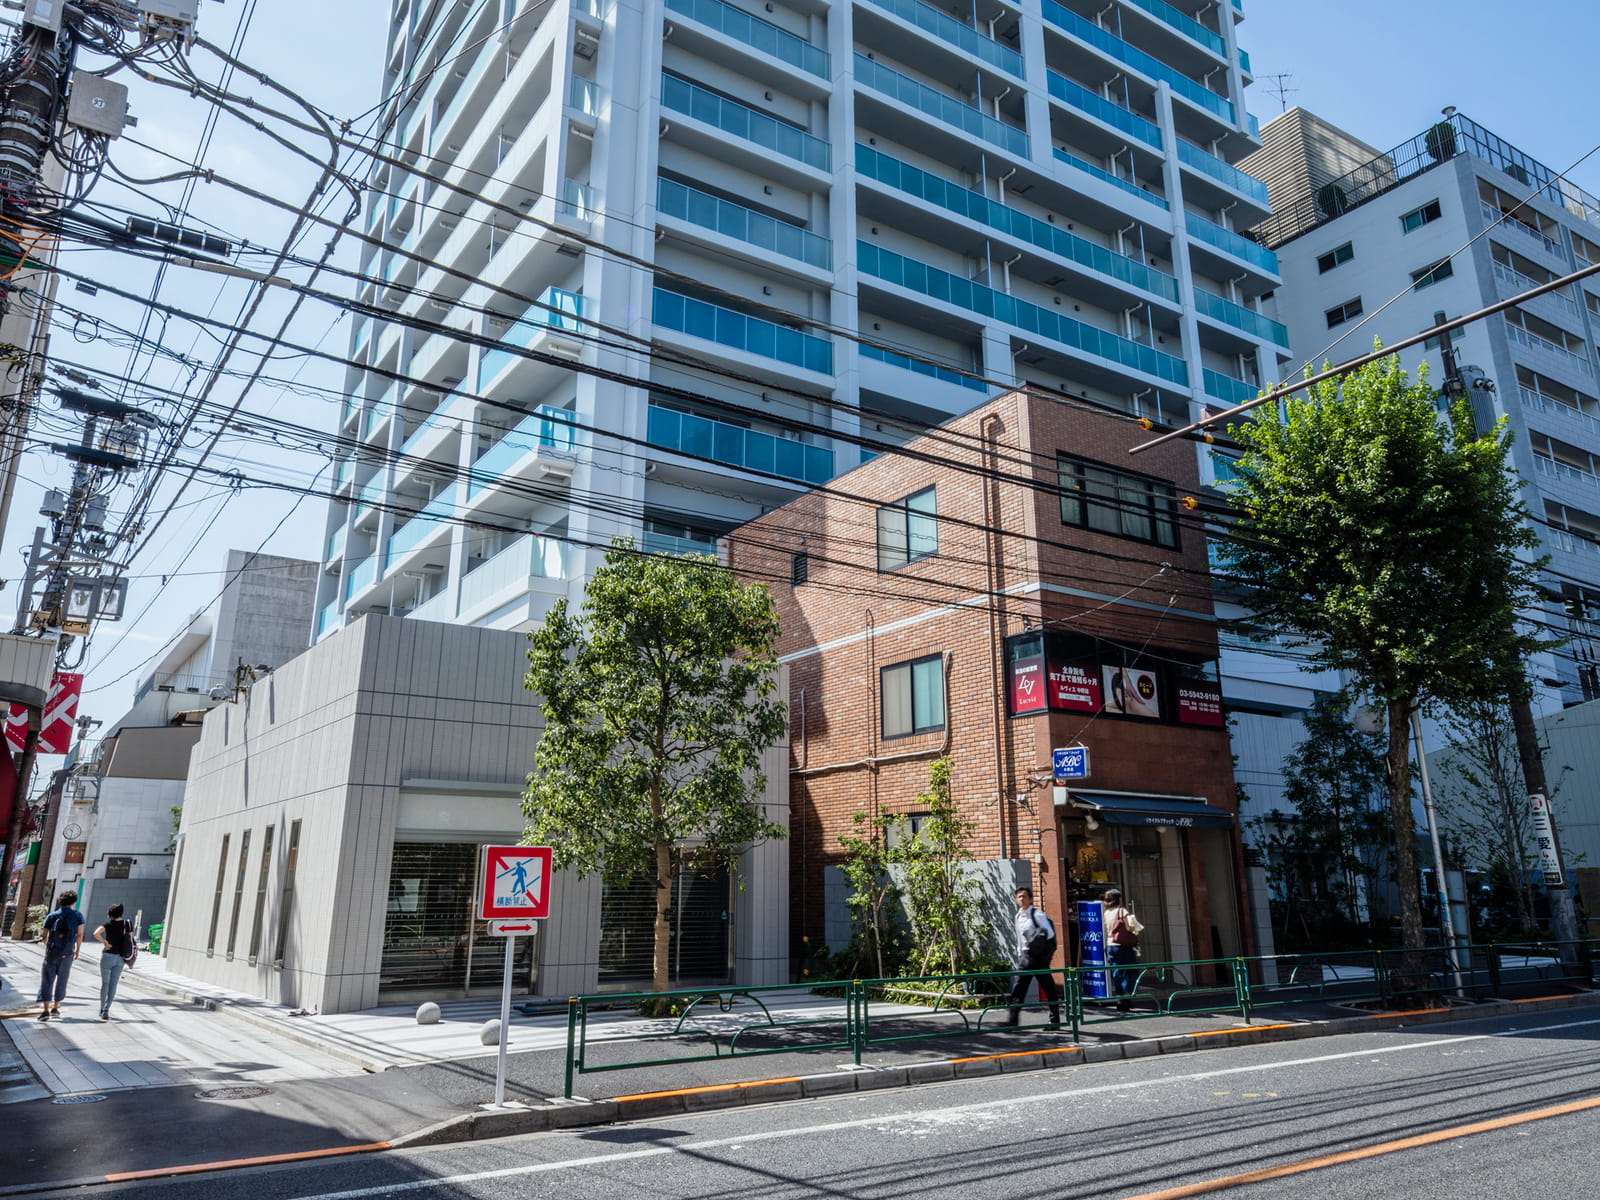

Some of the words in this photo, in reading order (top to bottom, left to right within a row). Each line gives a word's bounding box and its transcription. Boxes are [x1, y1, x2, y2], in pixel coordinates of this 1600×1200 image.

[1055, 754, 1082, 767] ABC
[496, 896, 527, 906] 横断禁止
